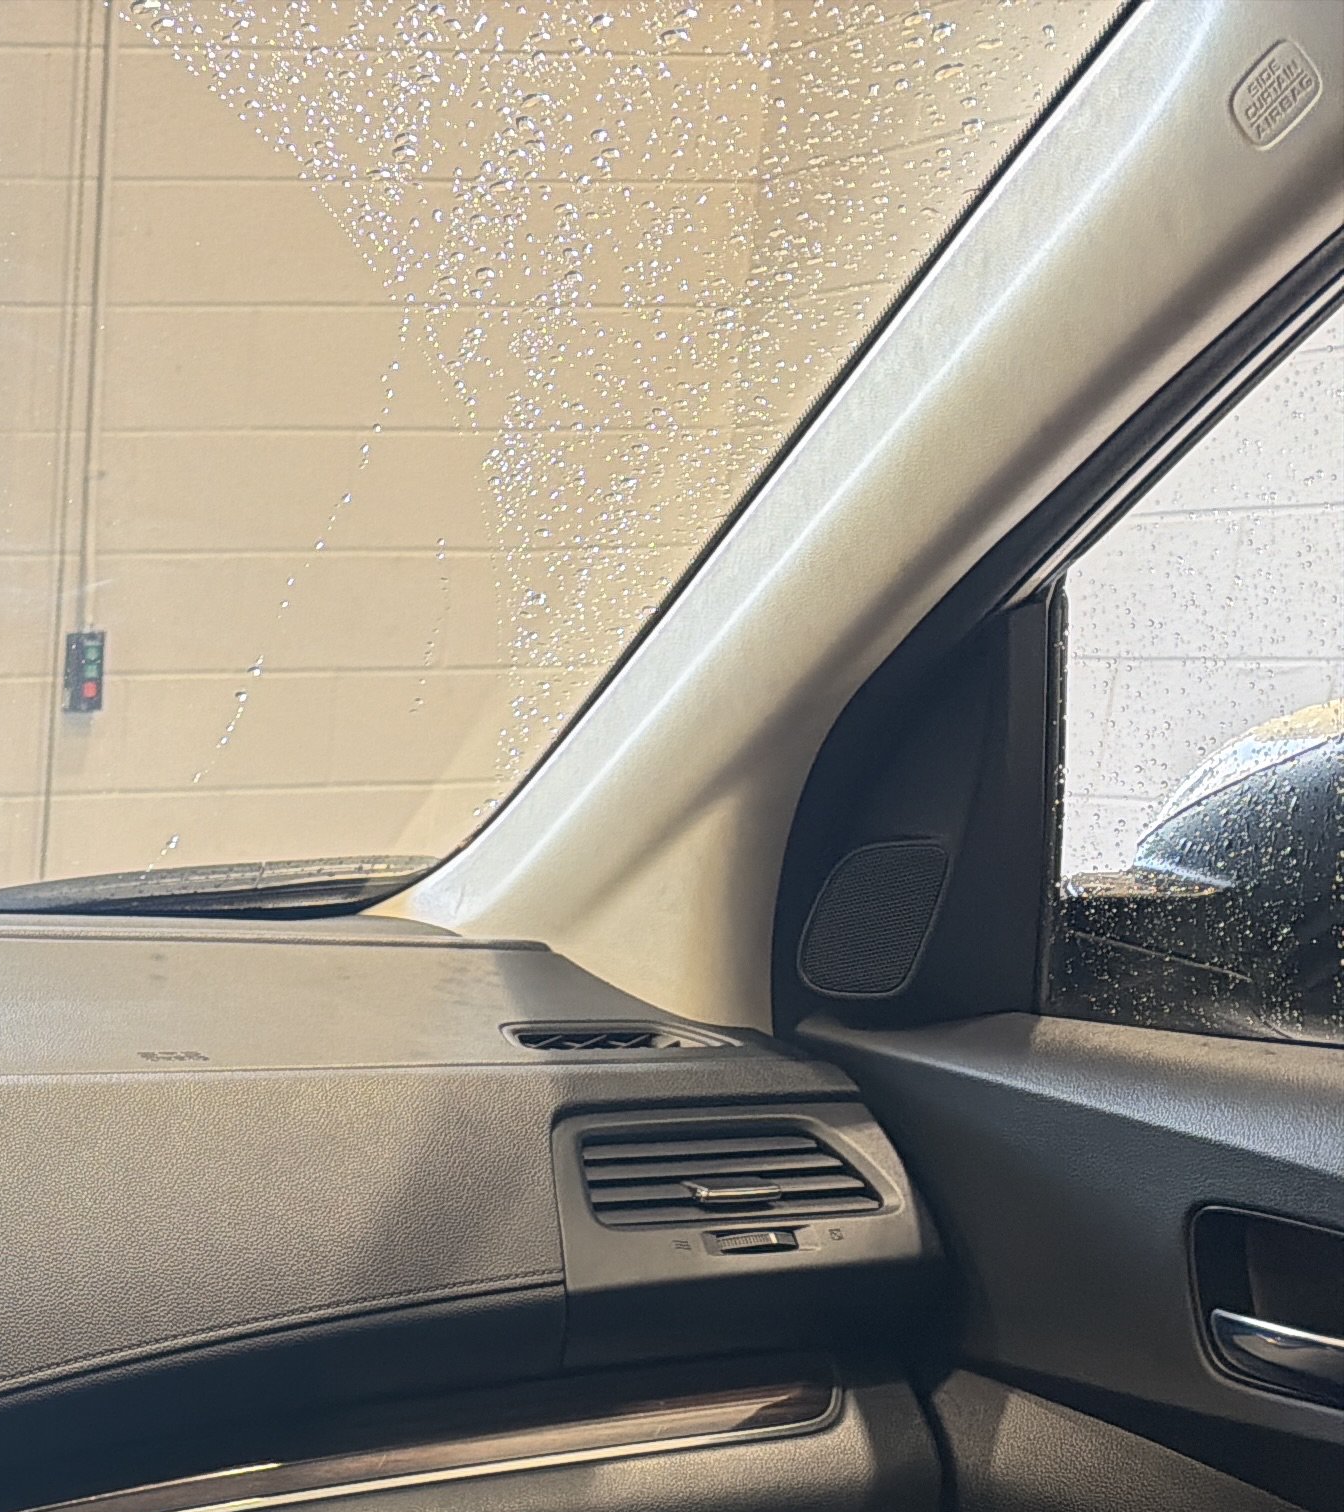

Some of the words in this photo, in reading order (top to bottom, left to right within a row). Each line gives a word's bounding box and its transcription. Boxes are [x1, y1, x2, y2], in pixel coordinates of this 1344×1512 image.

[1245, 59, 1298, 121] CURTAIN
[1248, 58, 1281, 97] SIDE
[1257, 73, 1312, 139] AIRBAG
